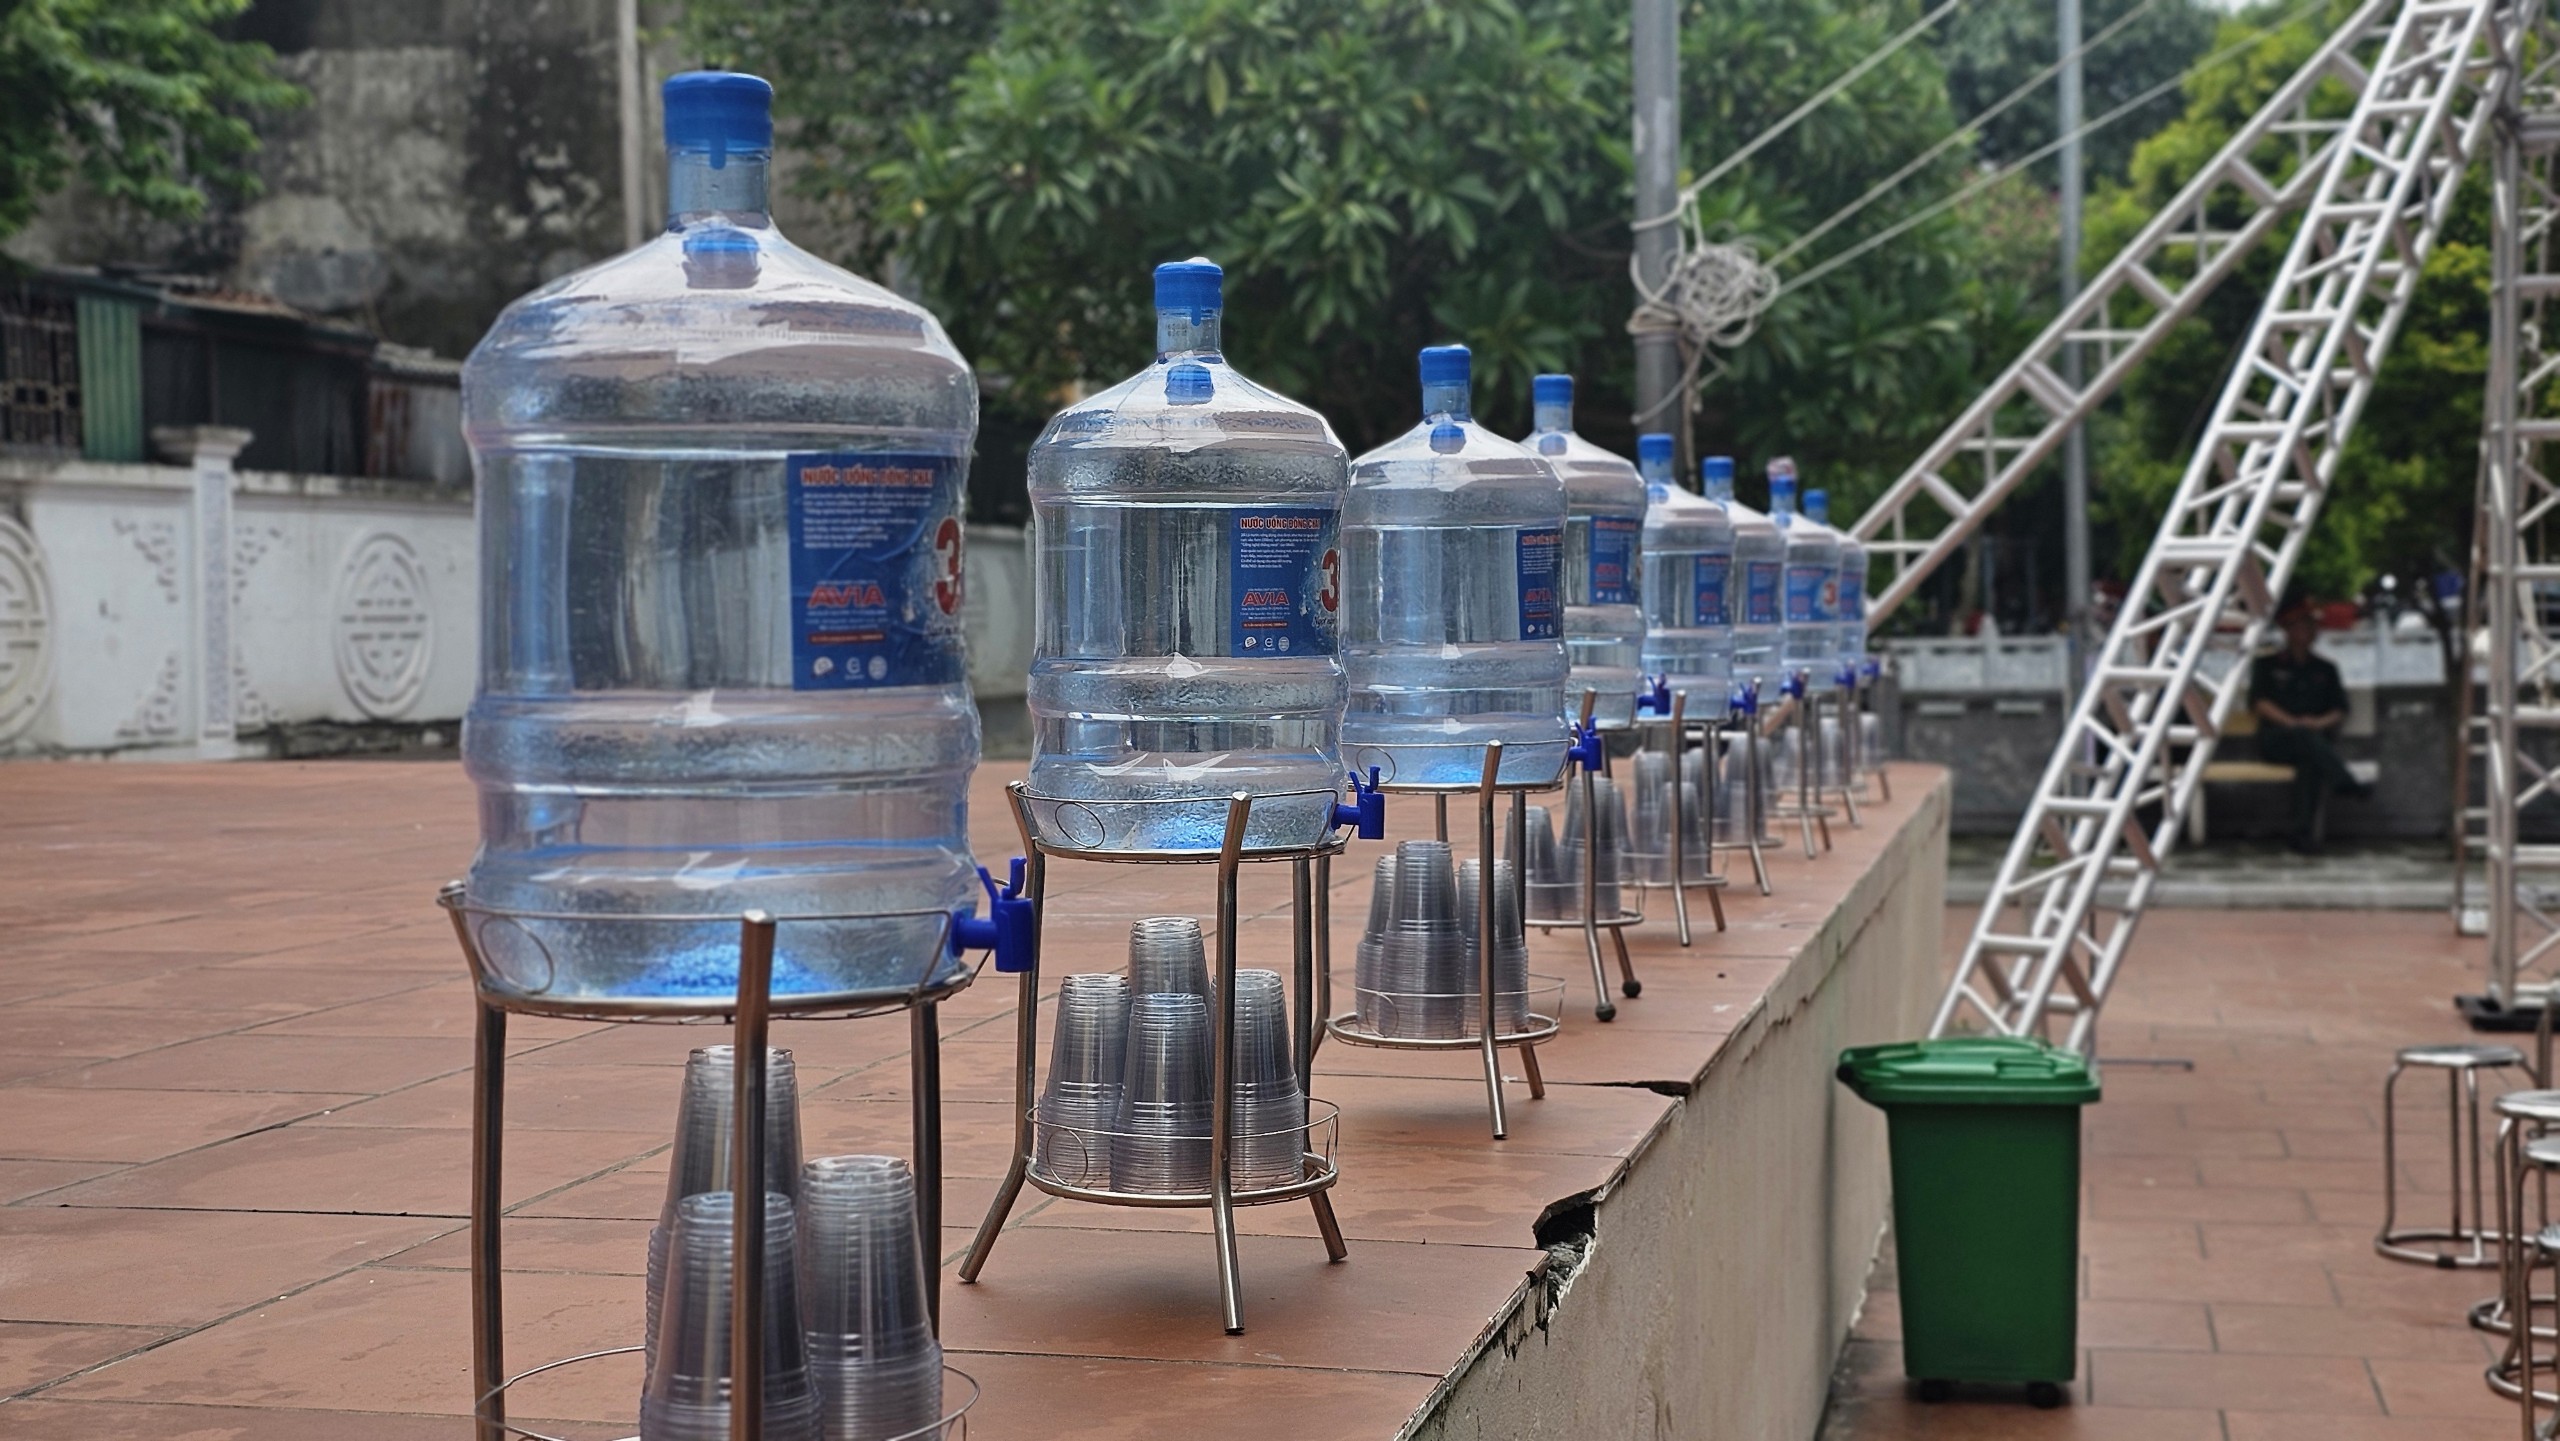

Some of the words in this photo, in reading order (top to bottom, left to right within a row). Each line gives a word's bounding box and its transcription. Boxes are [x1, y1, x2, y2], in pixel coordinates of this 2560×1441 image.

[1240, 515, 1264, 529] NƯỚC
[807, 585, 886, 609] AVIA
[1241, 592, 1290, 606] AVIA
